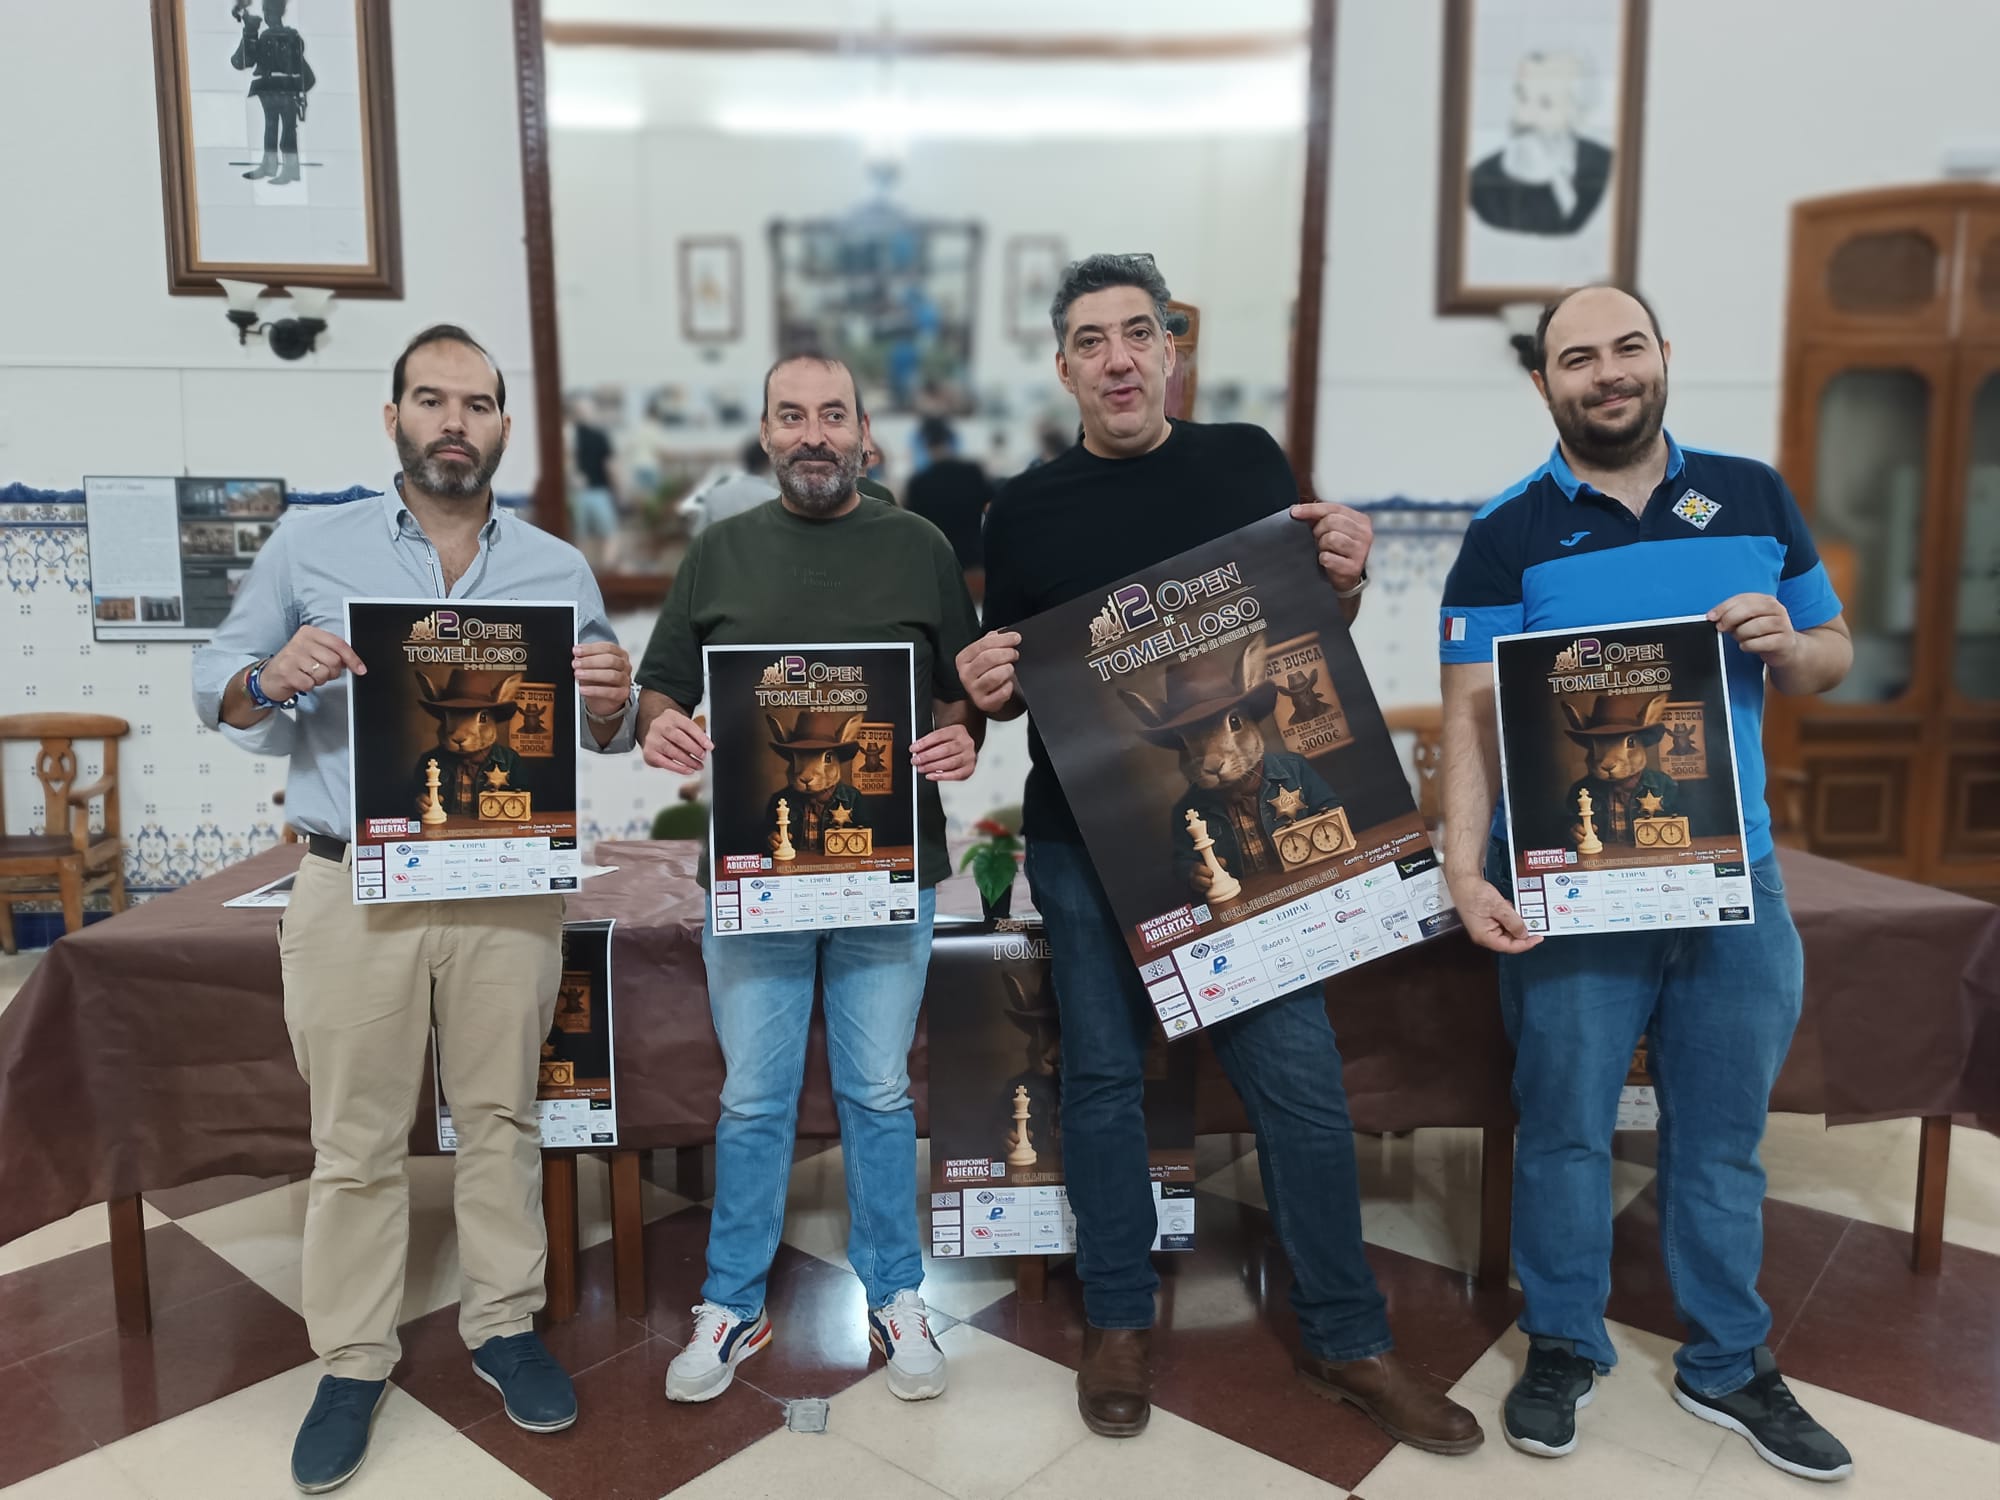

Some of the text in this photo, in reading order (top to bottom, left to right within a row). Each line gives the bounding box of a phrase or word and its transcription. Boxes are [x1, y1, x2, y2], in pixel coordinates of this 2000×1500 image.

[1114, 561, 1242, 632] 2 OPEN
[436, 610, 522, 640] 2 OPEN
[1163, 614, 1177, 627] DE
[1089, 596, 1261, 682] TOMELLOSO
[403, 646, 527, 664] TOMELLOSO
[1266, 647, 1322, 676] SE BUSCA
[1578, 638, 1664, 668] 2 OPEN
[784, 655, 863, 684] 2 OPEN
[1604, 663, 1613, 672] DE
[1548, 667, 1671, 694] TOMELLOSO
[755, 689, 868, 707] TOMELLOSO
[868, 731, 892, 741] BUSCA
[370, 825, 407, 833] ABIERTAS
[727, 861, 760, 869] ABIERTAS
[1344, 854, 1364, 866] Centro
[1364, 846, 1382, 857] Joven
[1528, 855, 1564, 865] ABIERTAS
[1140, 906, 1189, 932] INSCRIPCIONES
[1145, 915, 1194, 943] ABIERTAS
[946, 1166, 989, 1178] ABIERTAS
